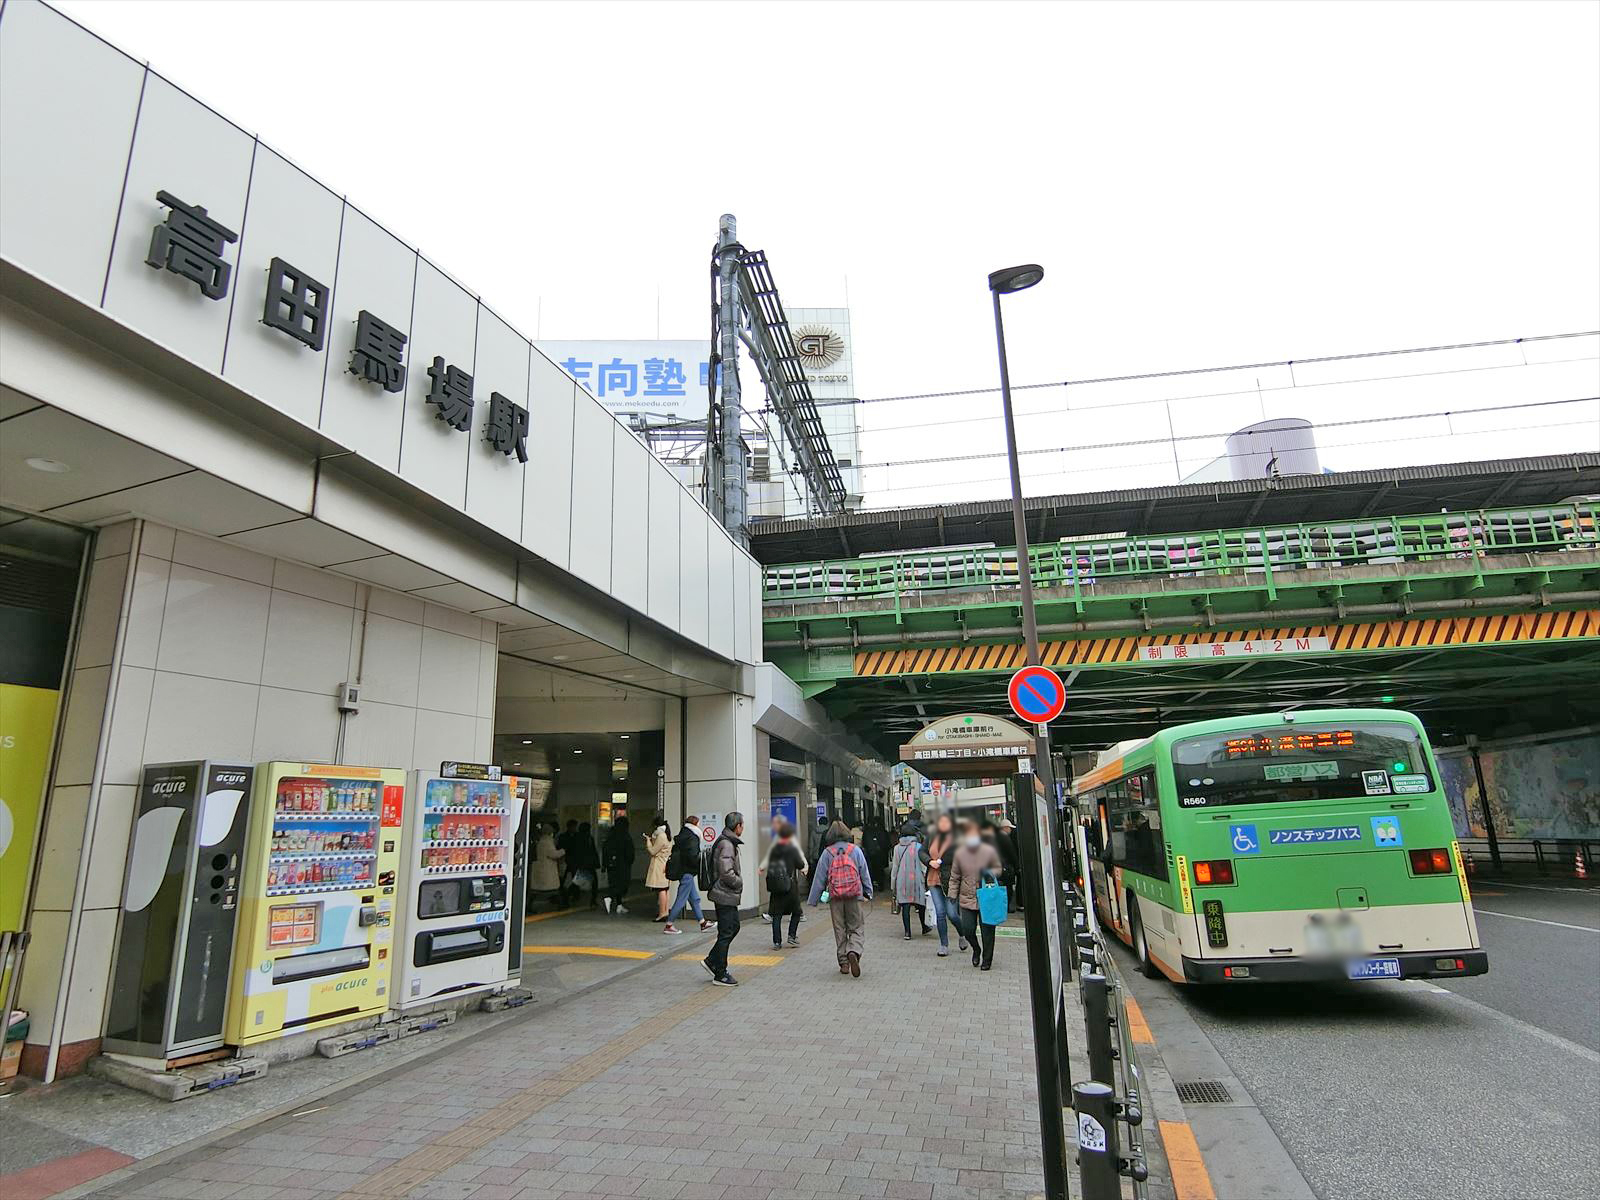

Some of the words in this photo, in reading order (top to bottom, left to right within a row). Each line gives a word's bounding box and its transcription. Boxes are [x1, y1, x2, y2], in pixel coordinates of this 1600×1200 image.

[144, 189, 529, 464] 高田馬場駅
[817, 375, 849, 383] TOKYO
[1265, 760, 1339, 779] 都営バス
[152, 781, 187, 794] acure
[216, 774, 247, 783] acure
[1183, 797, 1206, 805] R560
[1271, 827, 1361, 844] ノンステップバス
[475, 911, 504, 923] acure
[335, 977, 368, 992] acure
